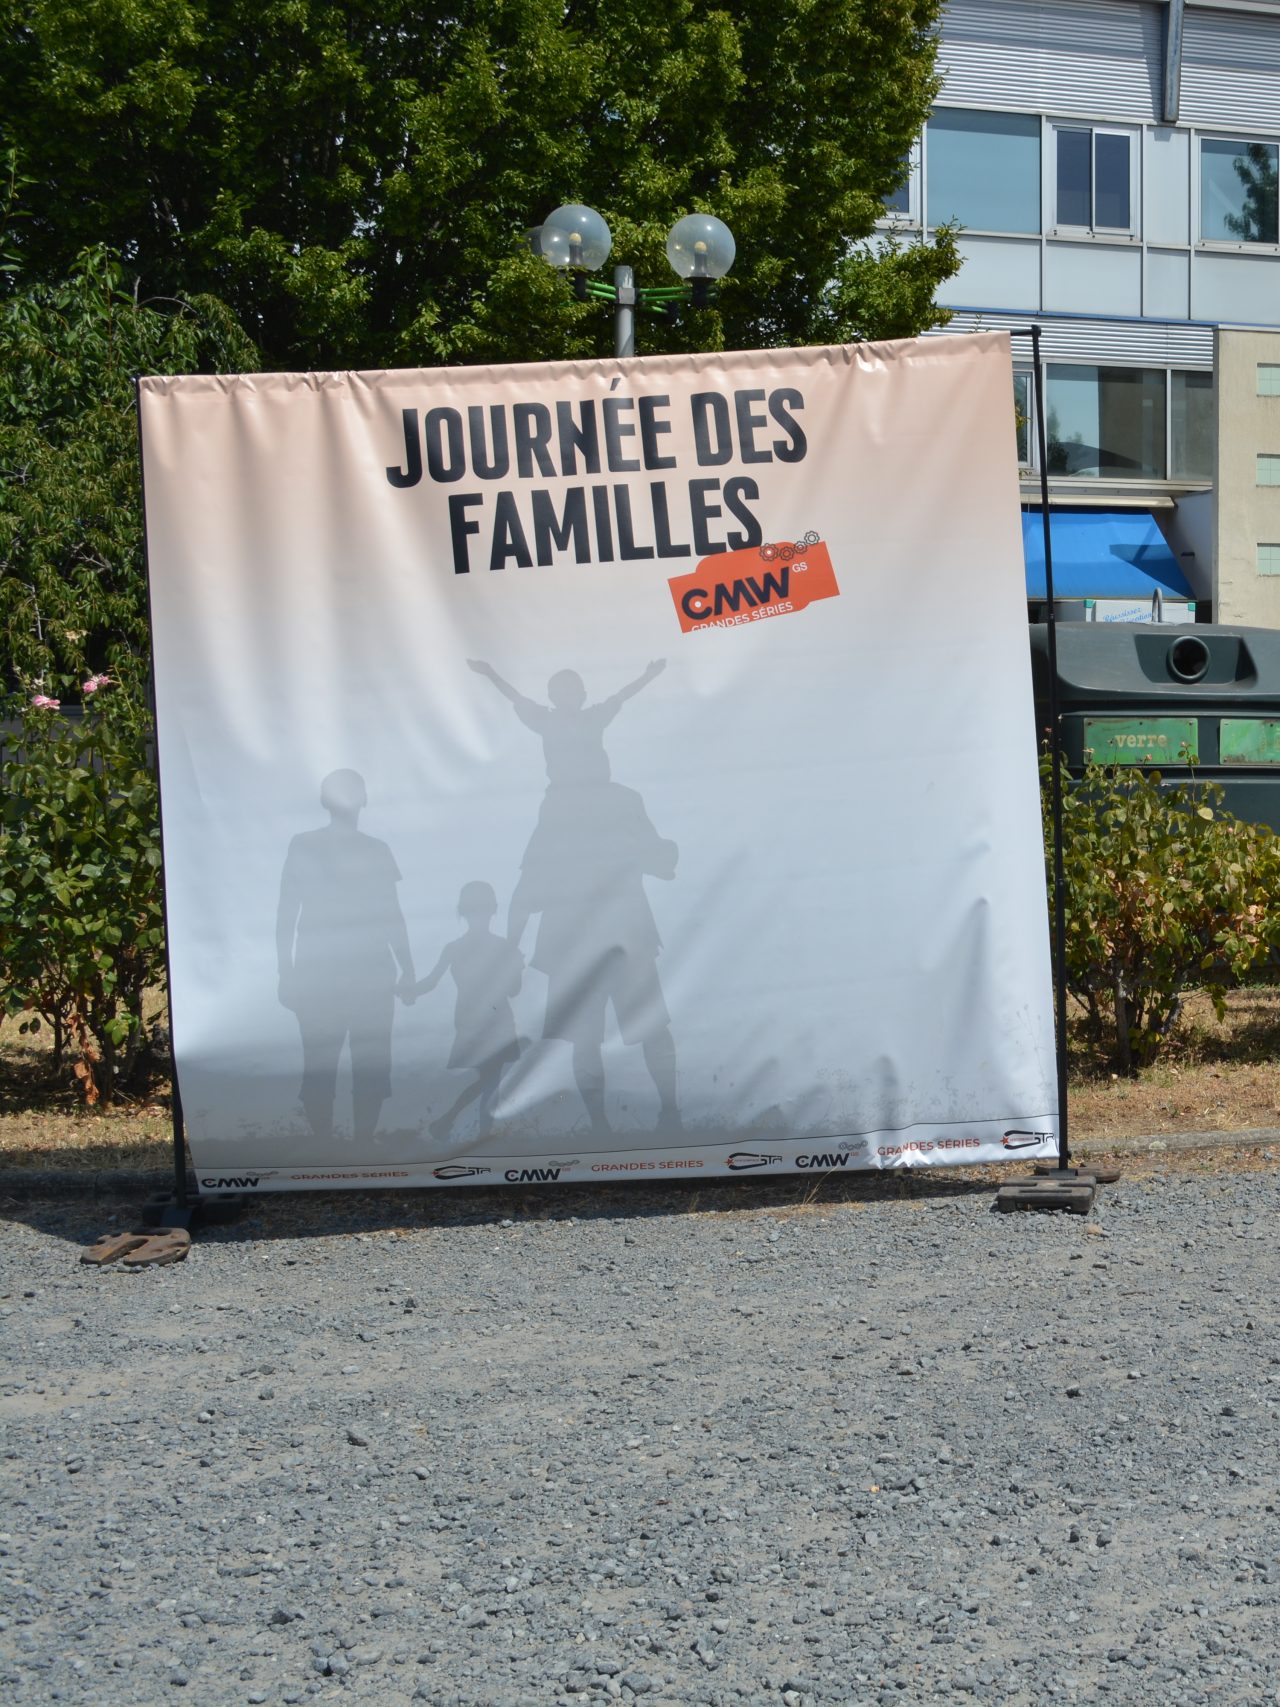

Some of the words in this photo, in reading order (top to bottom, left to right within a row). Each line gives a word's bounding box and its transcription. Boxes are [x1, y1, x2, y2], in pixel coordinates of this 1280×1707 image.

[386, 377, 676, 488] JOURNÉE
[691, 388, 807, 467] DES
[448, 476, 763, 575] FAMILLES
[681, 566, 790, 620] CMW
[791, 562, 808, 573] GS
[752, 601, 793, 621] SÉRIES
[1114, 734, 1167, 748] verre
[201, 1177, 260, 1188] CMW
[504, 1168, 561, 1182] CMW
[591, 1161, 656, 1172] GRANDES
[658, 1159, 704, 1170] SÉRIES
[795, 1152, 849, 1168] CMW
[877, 1141, 934, 1156] GRANDES
[937, 1138, 981, 1150] SÉRIES
